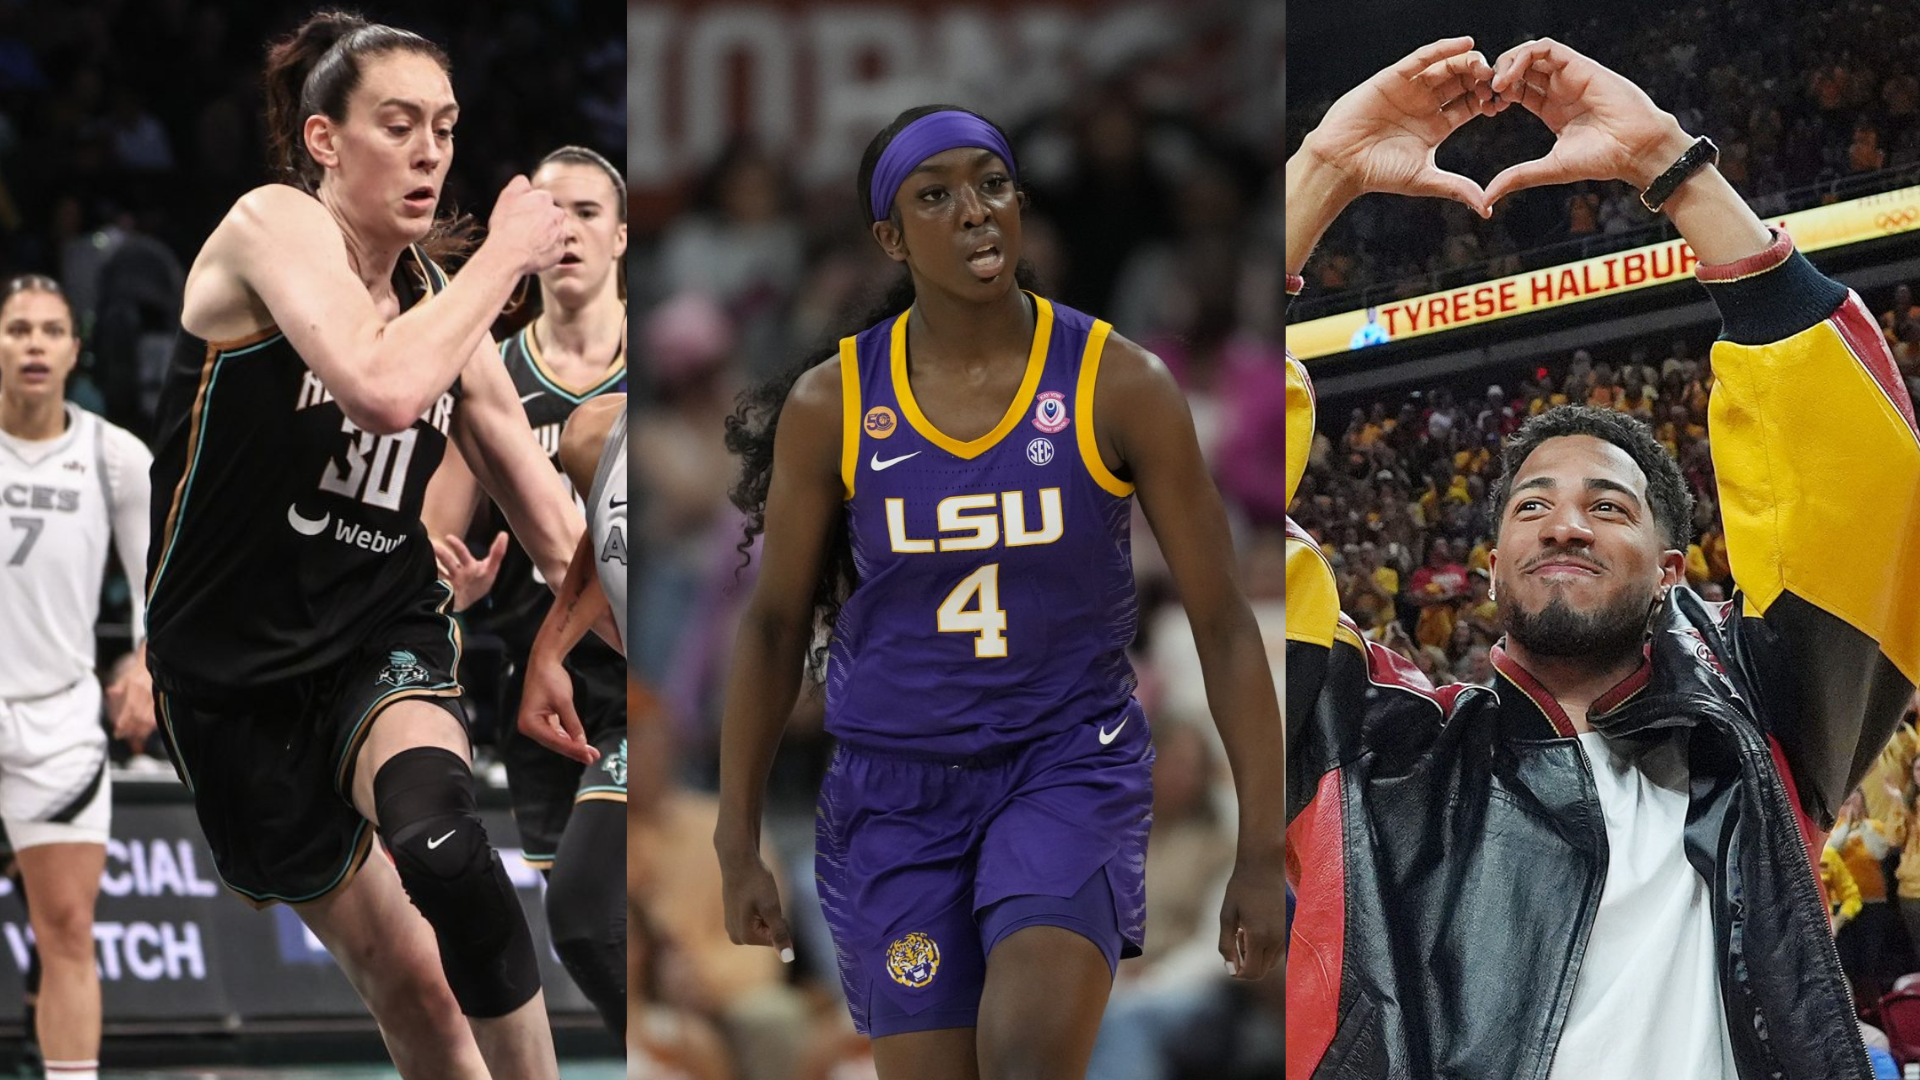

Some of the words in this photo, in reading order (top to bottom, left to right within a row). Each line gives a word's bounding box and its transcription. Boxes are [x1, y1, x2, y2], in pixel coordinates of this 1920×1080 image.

[1382, 281, 1518, 337] TYRESE
[1531, 243, 1699, 306] HALIBUR
[318, 414, 420, 512] 30
[1029, 440, 1052, 463] SEC
[0, 484, 80, 512] CES
[885, 487, 1064, 553] LSU
[6, 516, 45, 567] 7
[936, 563, 1008, 657] 4
